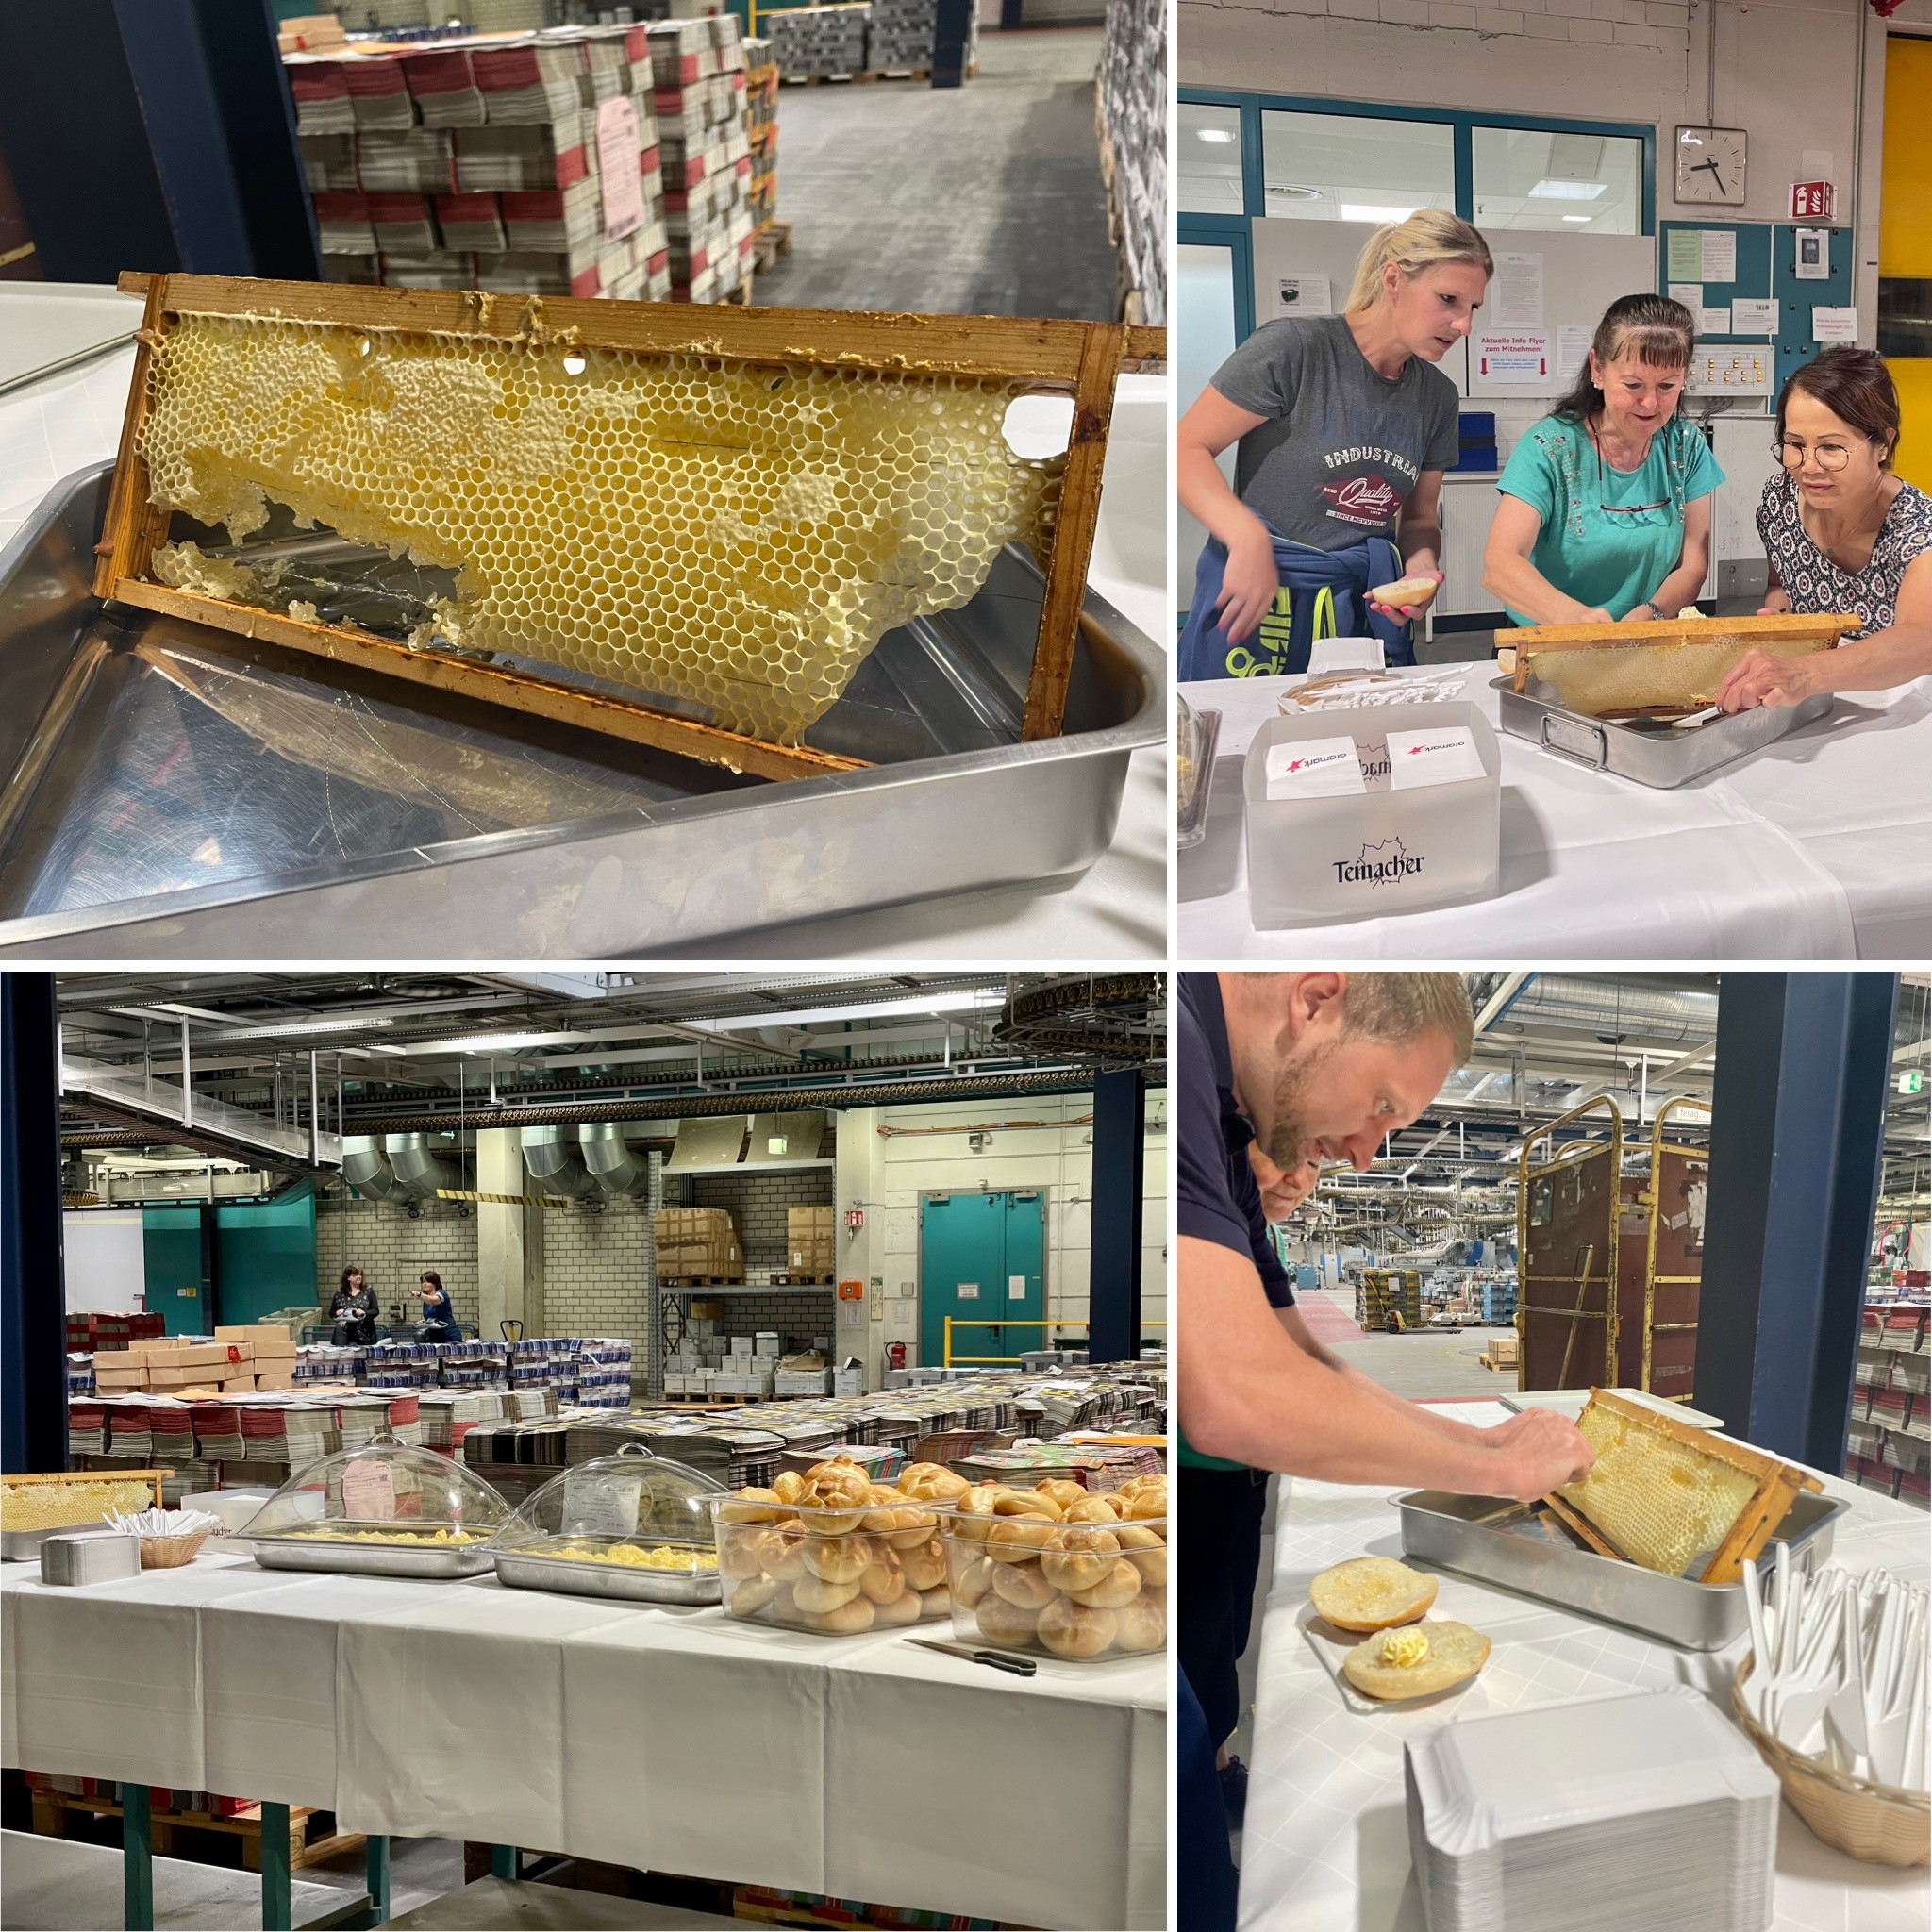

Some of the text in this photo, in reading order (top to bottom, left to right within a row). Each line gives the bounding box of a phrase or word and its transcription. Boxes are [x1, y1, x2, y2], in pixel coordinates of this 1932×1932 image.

[1512, 337, 1546, 345] Info-Flyer
[1336, 477, 1393, 508] Quality
[1333, 511, 1352, 521] SINCE
[1424, 741, 1465, 752] aramark
[1304, 753, 1347, 767] aramark
[1332, 855, 1425, 883] Teinacher
